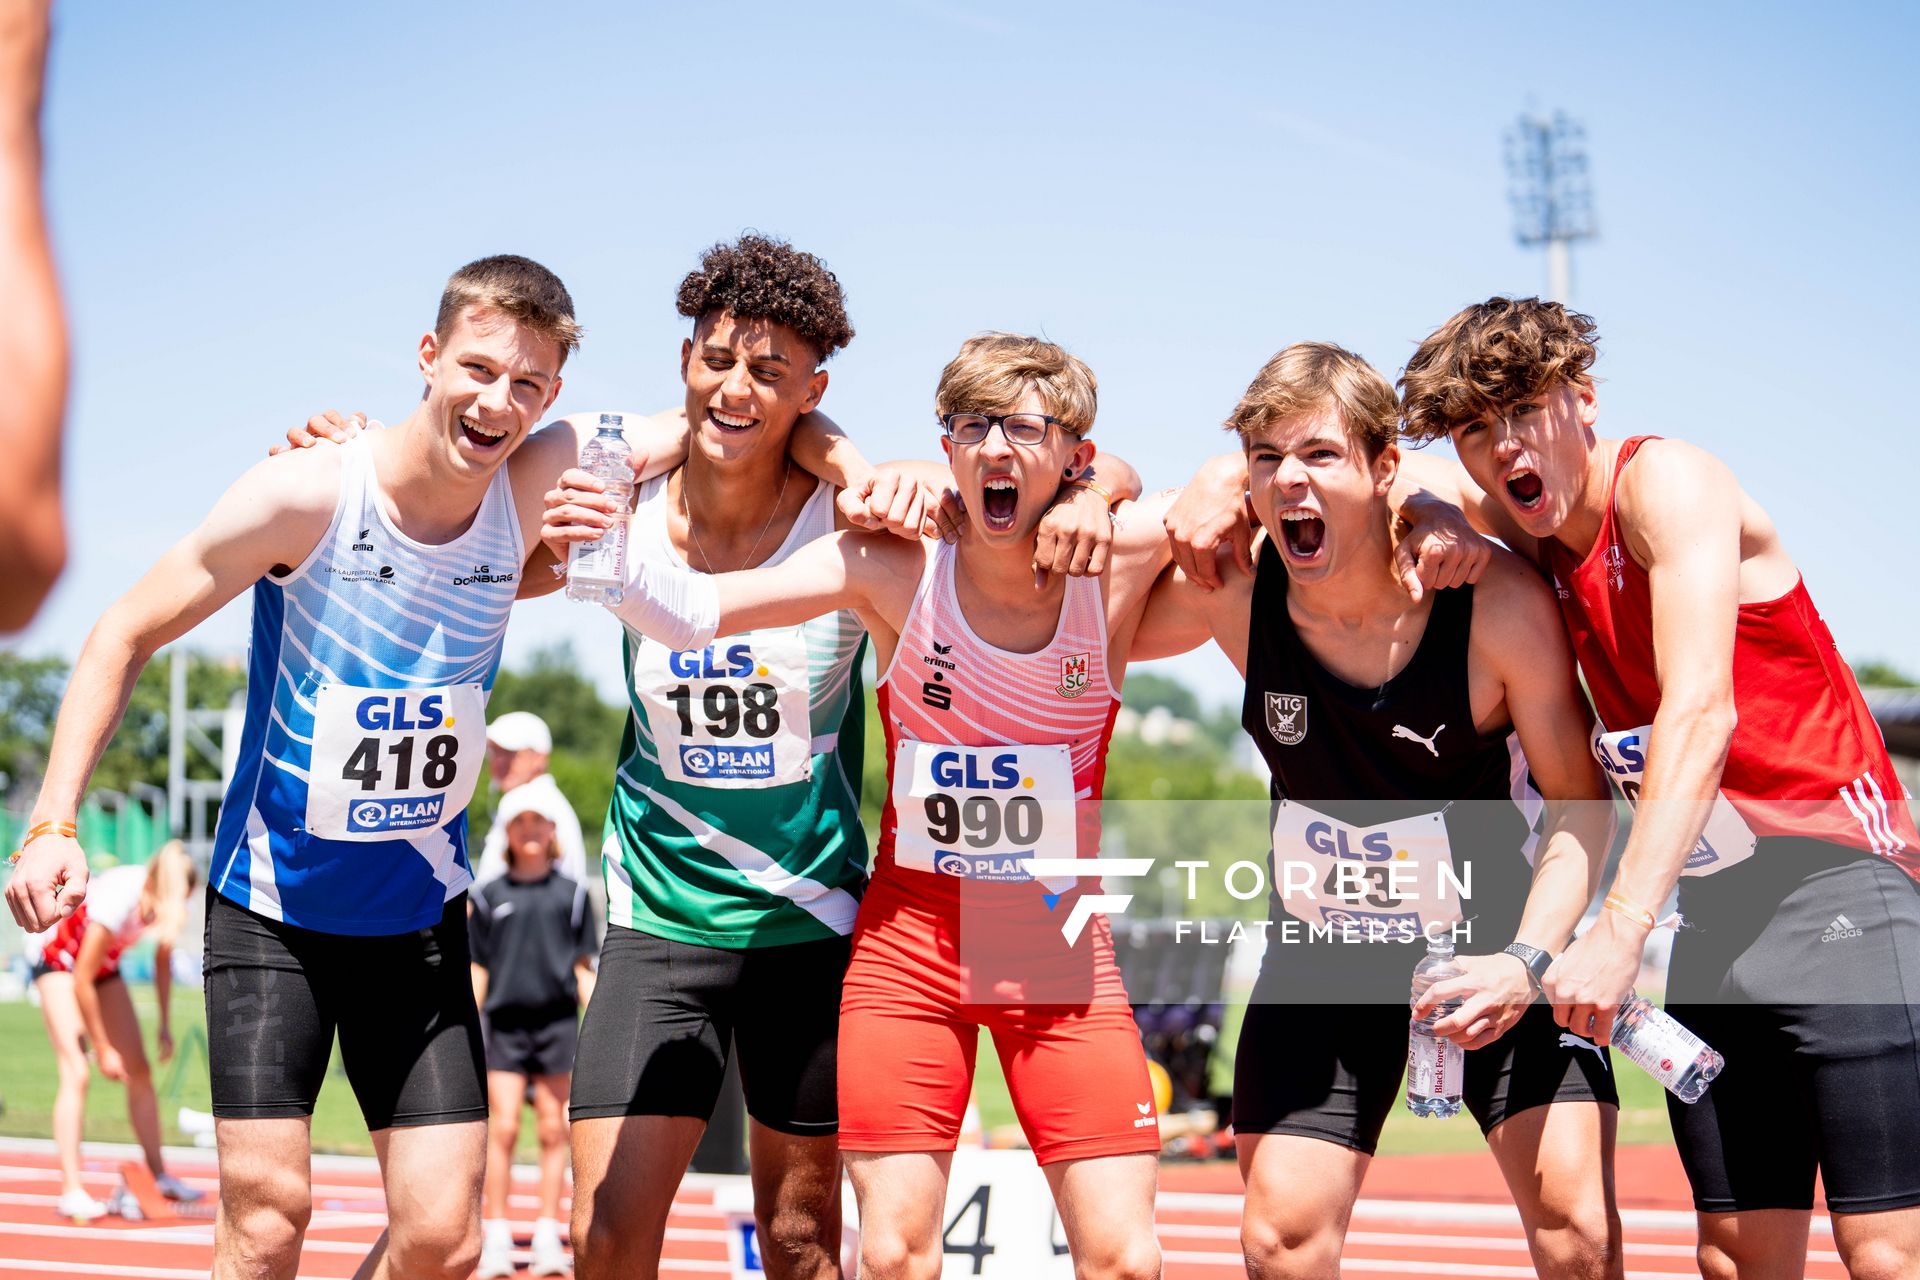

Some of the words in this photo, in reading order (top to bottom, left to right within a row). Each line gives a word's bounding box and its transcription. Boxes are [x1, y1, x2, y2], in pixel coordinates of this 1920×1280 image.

[474, 565, 489, 573] LG
[924, 656, 956, 670] erima
[1065, 672, 1085, 689] SC
[666, 683, 780, 738] 198
[1270, 695, 1302, 711] MTG
[1271, 726, 1304, 742] MANNHEIM
[342, 734, 459, 791] 418
[717, 751, 770, 766] PLAN
[389, 801, 440, 819] PLAN
[389, 817, 437, 827] INTERNATIONAL
[924, 793, 1043, 848] 990
[1821, 928, 1864, 943] adidas
[1435, 1042, 1445, 1069] Forest
[1434, 1070, 1443, 1094] Black
[942, 1185, 995, 1275] 4
